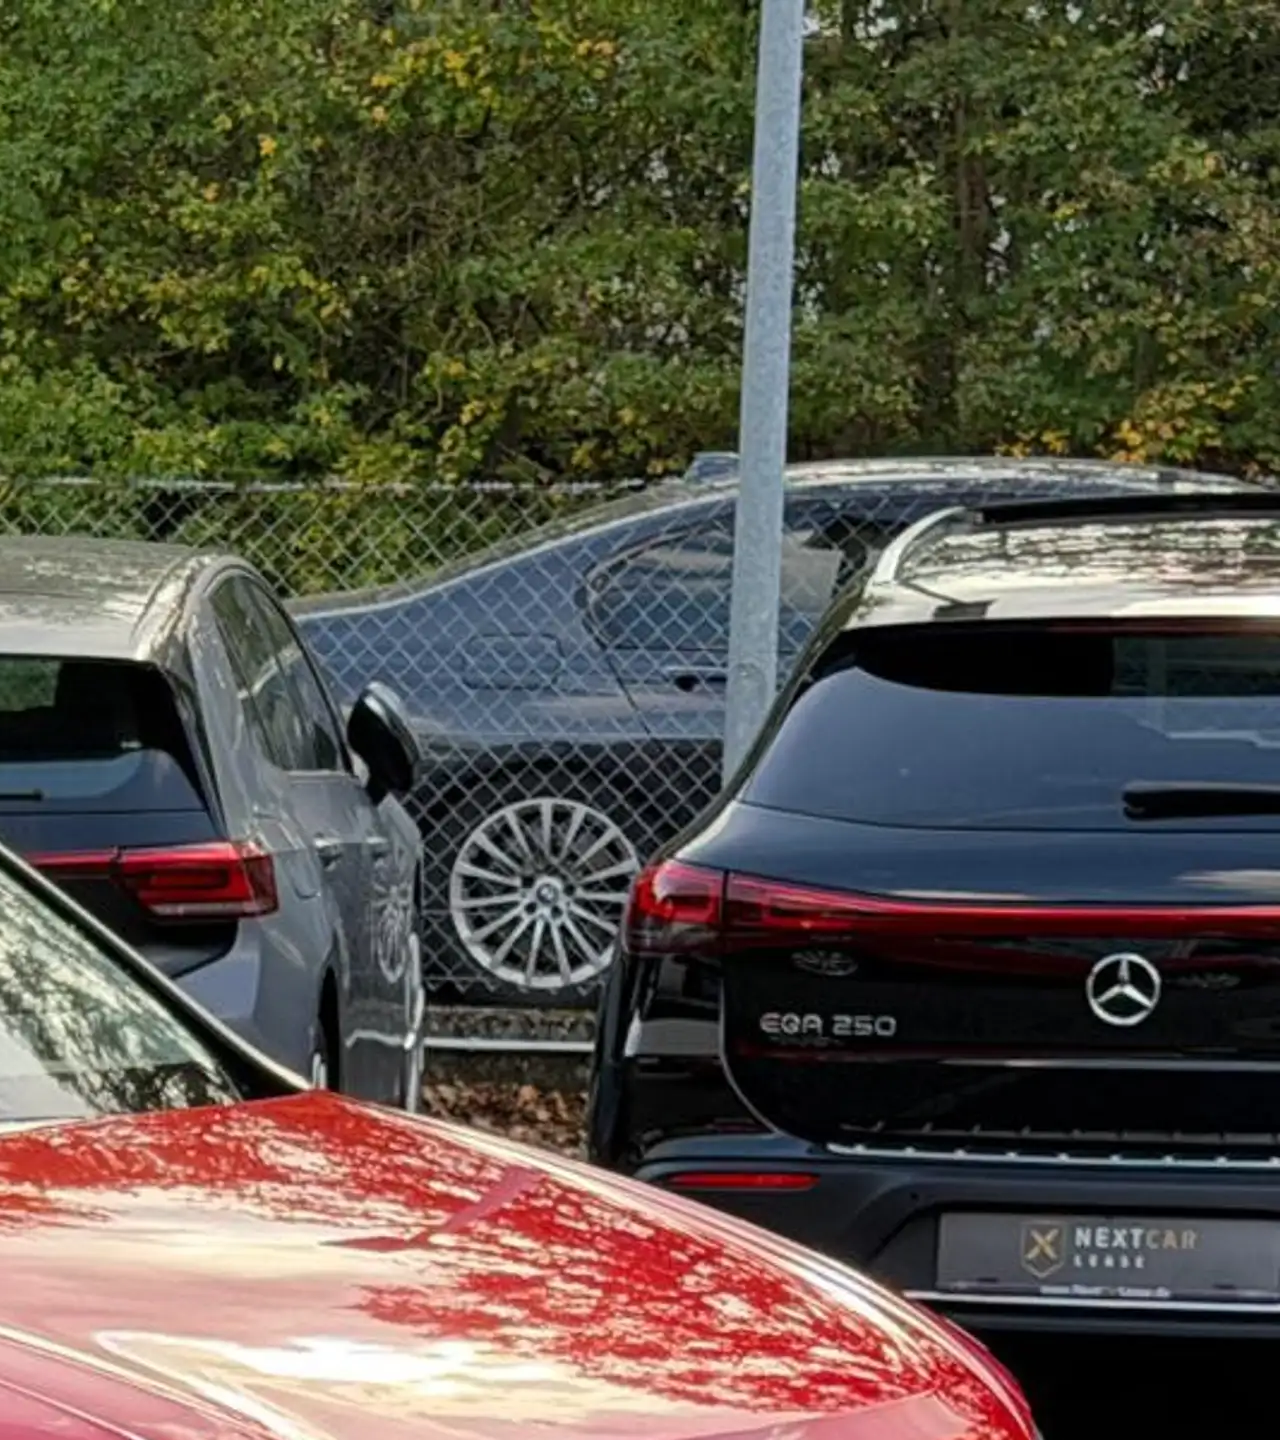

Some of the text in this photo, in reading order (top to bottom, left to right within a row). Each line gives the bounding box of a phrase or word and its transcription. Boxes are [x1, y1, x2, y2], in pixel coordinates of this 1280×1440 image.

[760, 1012, 896, 1036] EQA 250
[1074, 1227, 1197, 1249] NEXTCAR
